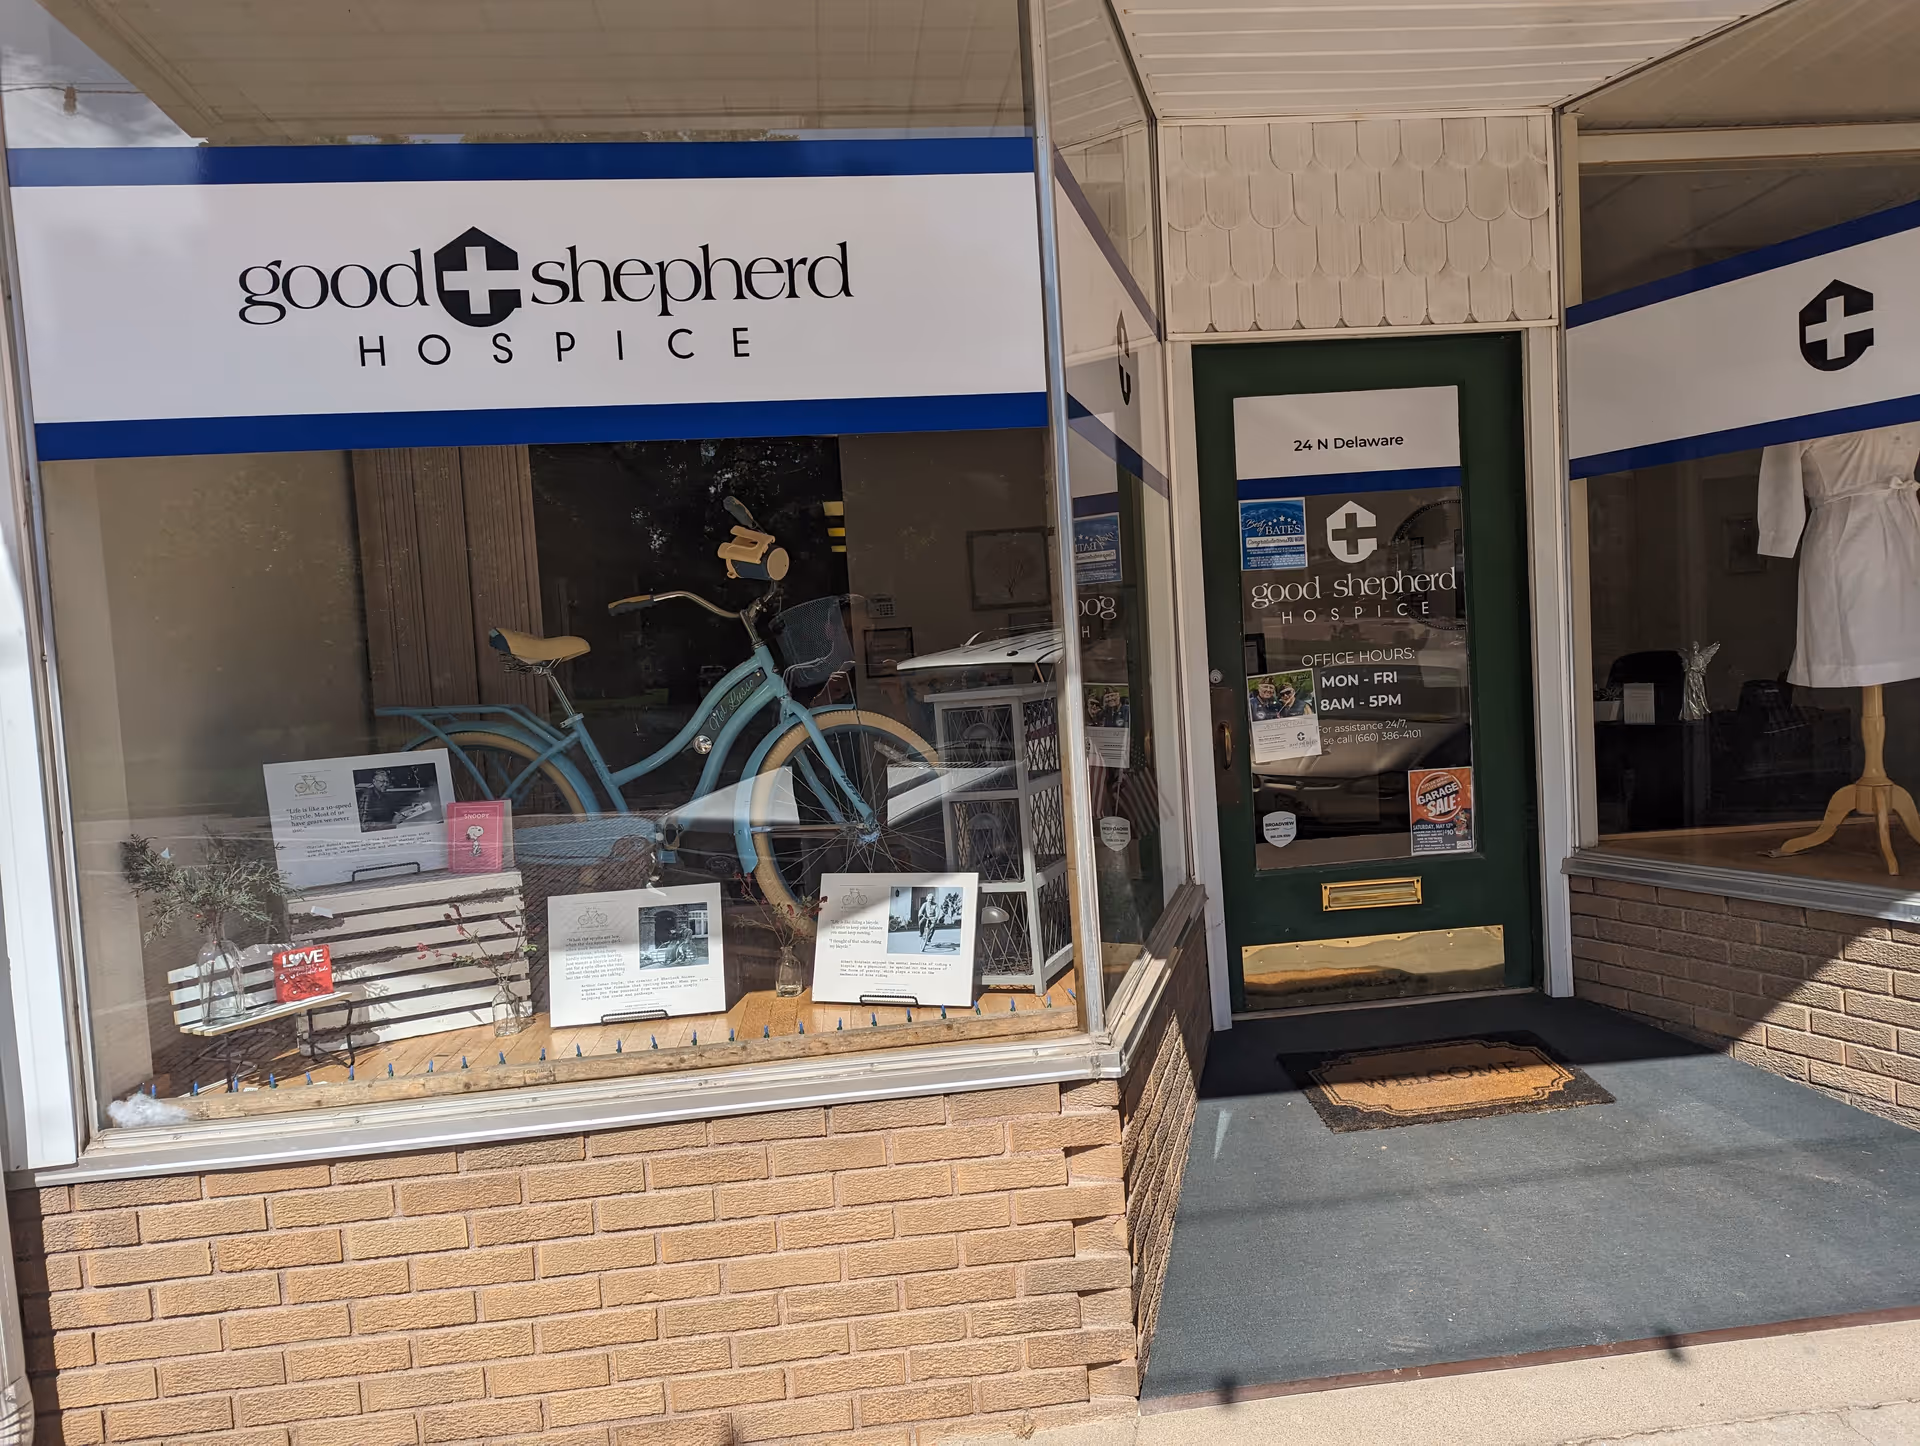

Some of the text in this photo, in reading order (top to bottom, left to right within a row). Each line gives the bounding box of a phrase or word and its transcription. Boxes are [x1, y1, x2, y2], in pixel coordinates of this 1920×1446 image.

[238, 241, 855, 326] good shepherd
[358, 326, 750, 367] HOSPICE
[1293, 435, 1404, 452] 24 N Delaware
[1265, 525, 1301, 536] BATES
[1251, 566, 1457, 609] good shepherd
[1281, 601, 1429, 625] HOSPICE
[1301, 647, 1416, 667] OFFICE HOURS:
[1321, 674, 1359, 689] MON
[1373, 671, 1398, 685] FRI
[1320, 697, 1355, 711] 8AM
[1369, 694, 1402, 707] 5PM
[1334, 721, 1383, 734] assistance
[1385, 718, 1408, 730] 24/7,
[1336, 734, 1353, 744] call
[1355, 732, 1379, 745] (660)
[1381, 729, 1422, 741] 386-4101
[1417, 782, 1459, 805] GARAGE
[1427, 793, 1457, 817] SALE
[1413, 823, 1436, 831] SATURDAY,
[282, 949, 325, 968] LOVE
[1359, 1061, 1525, 1089] WELCOME
